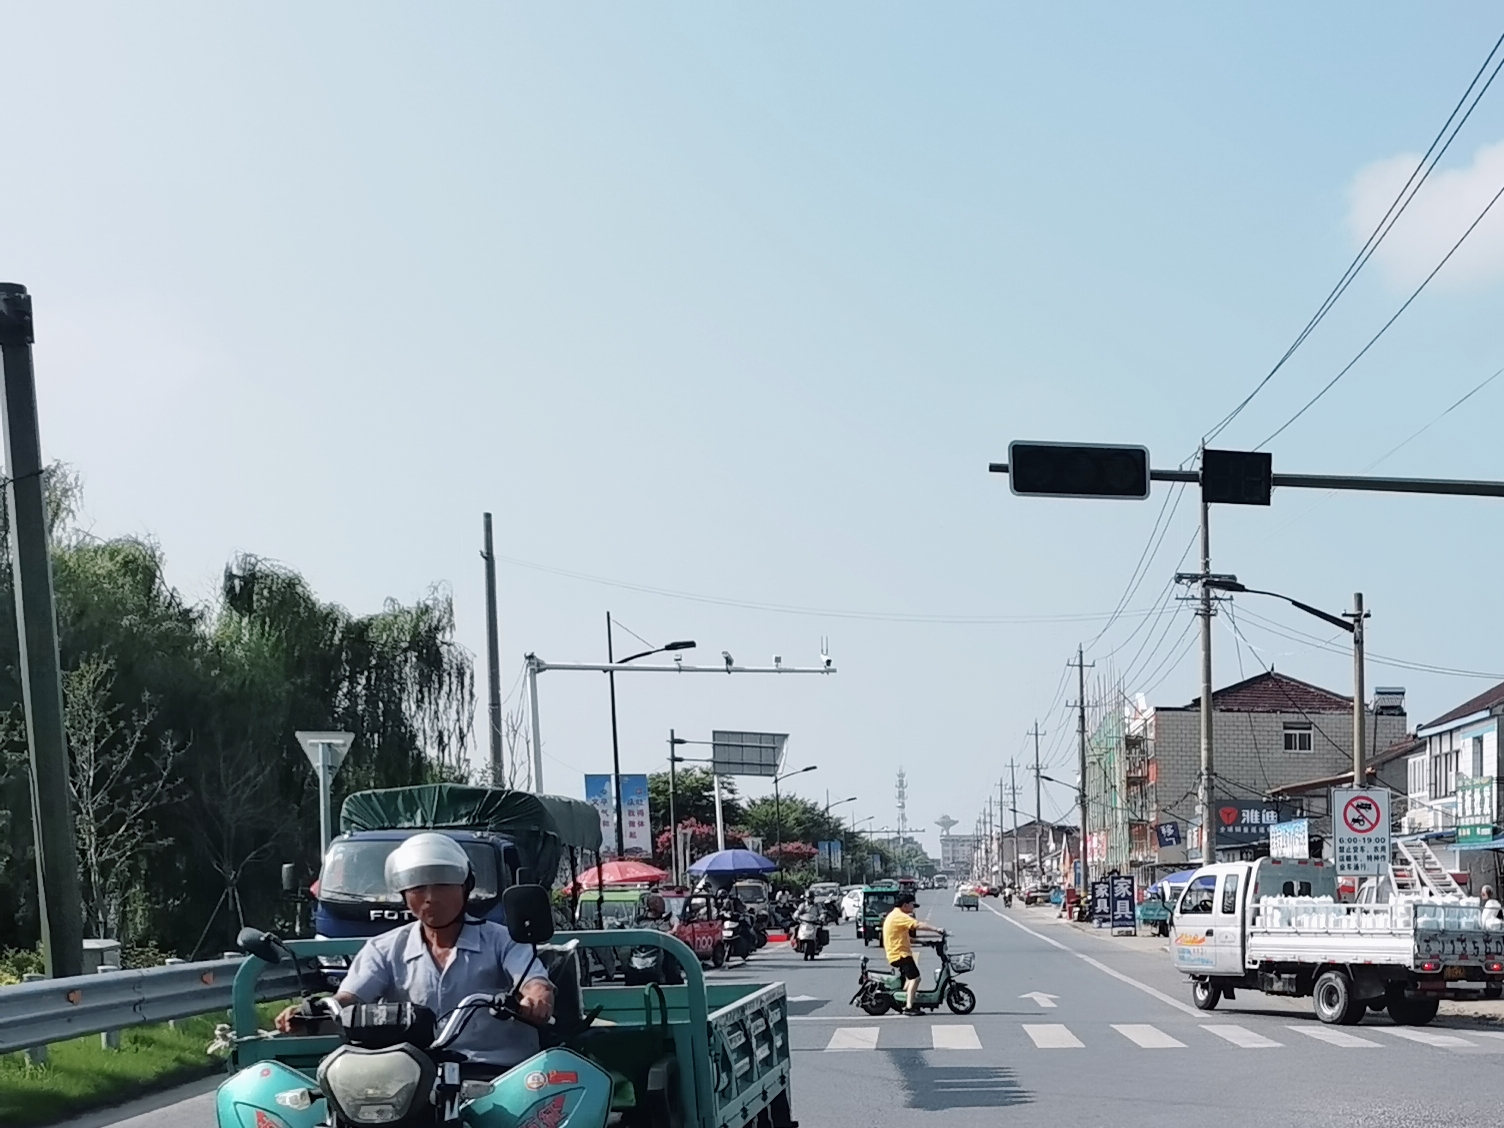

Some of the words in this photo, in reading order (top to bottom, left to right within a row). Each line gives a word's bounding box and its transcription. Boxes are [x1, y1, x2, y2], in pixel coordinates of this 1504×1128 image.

[1241, 808, 1278, 824] 雅迪
[1094, 883, 1110, 914] 家具
[1114, 877, 1133, 920] 家具
[369, 909, 413, 921] FOT
